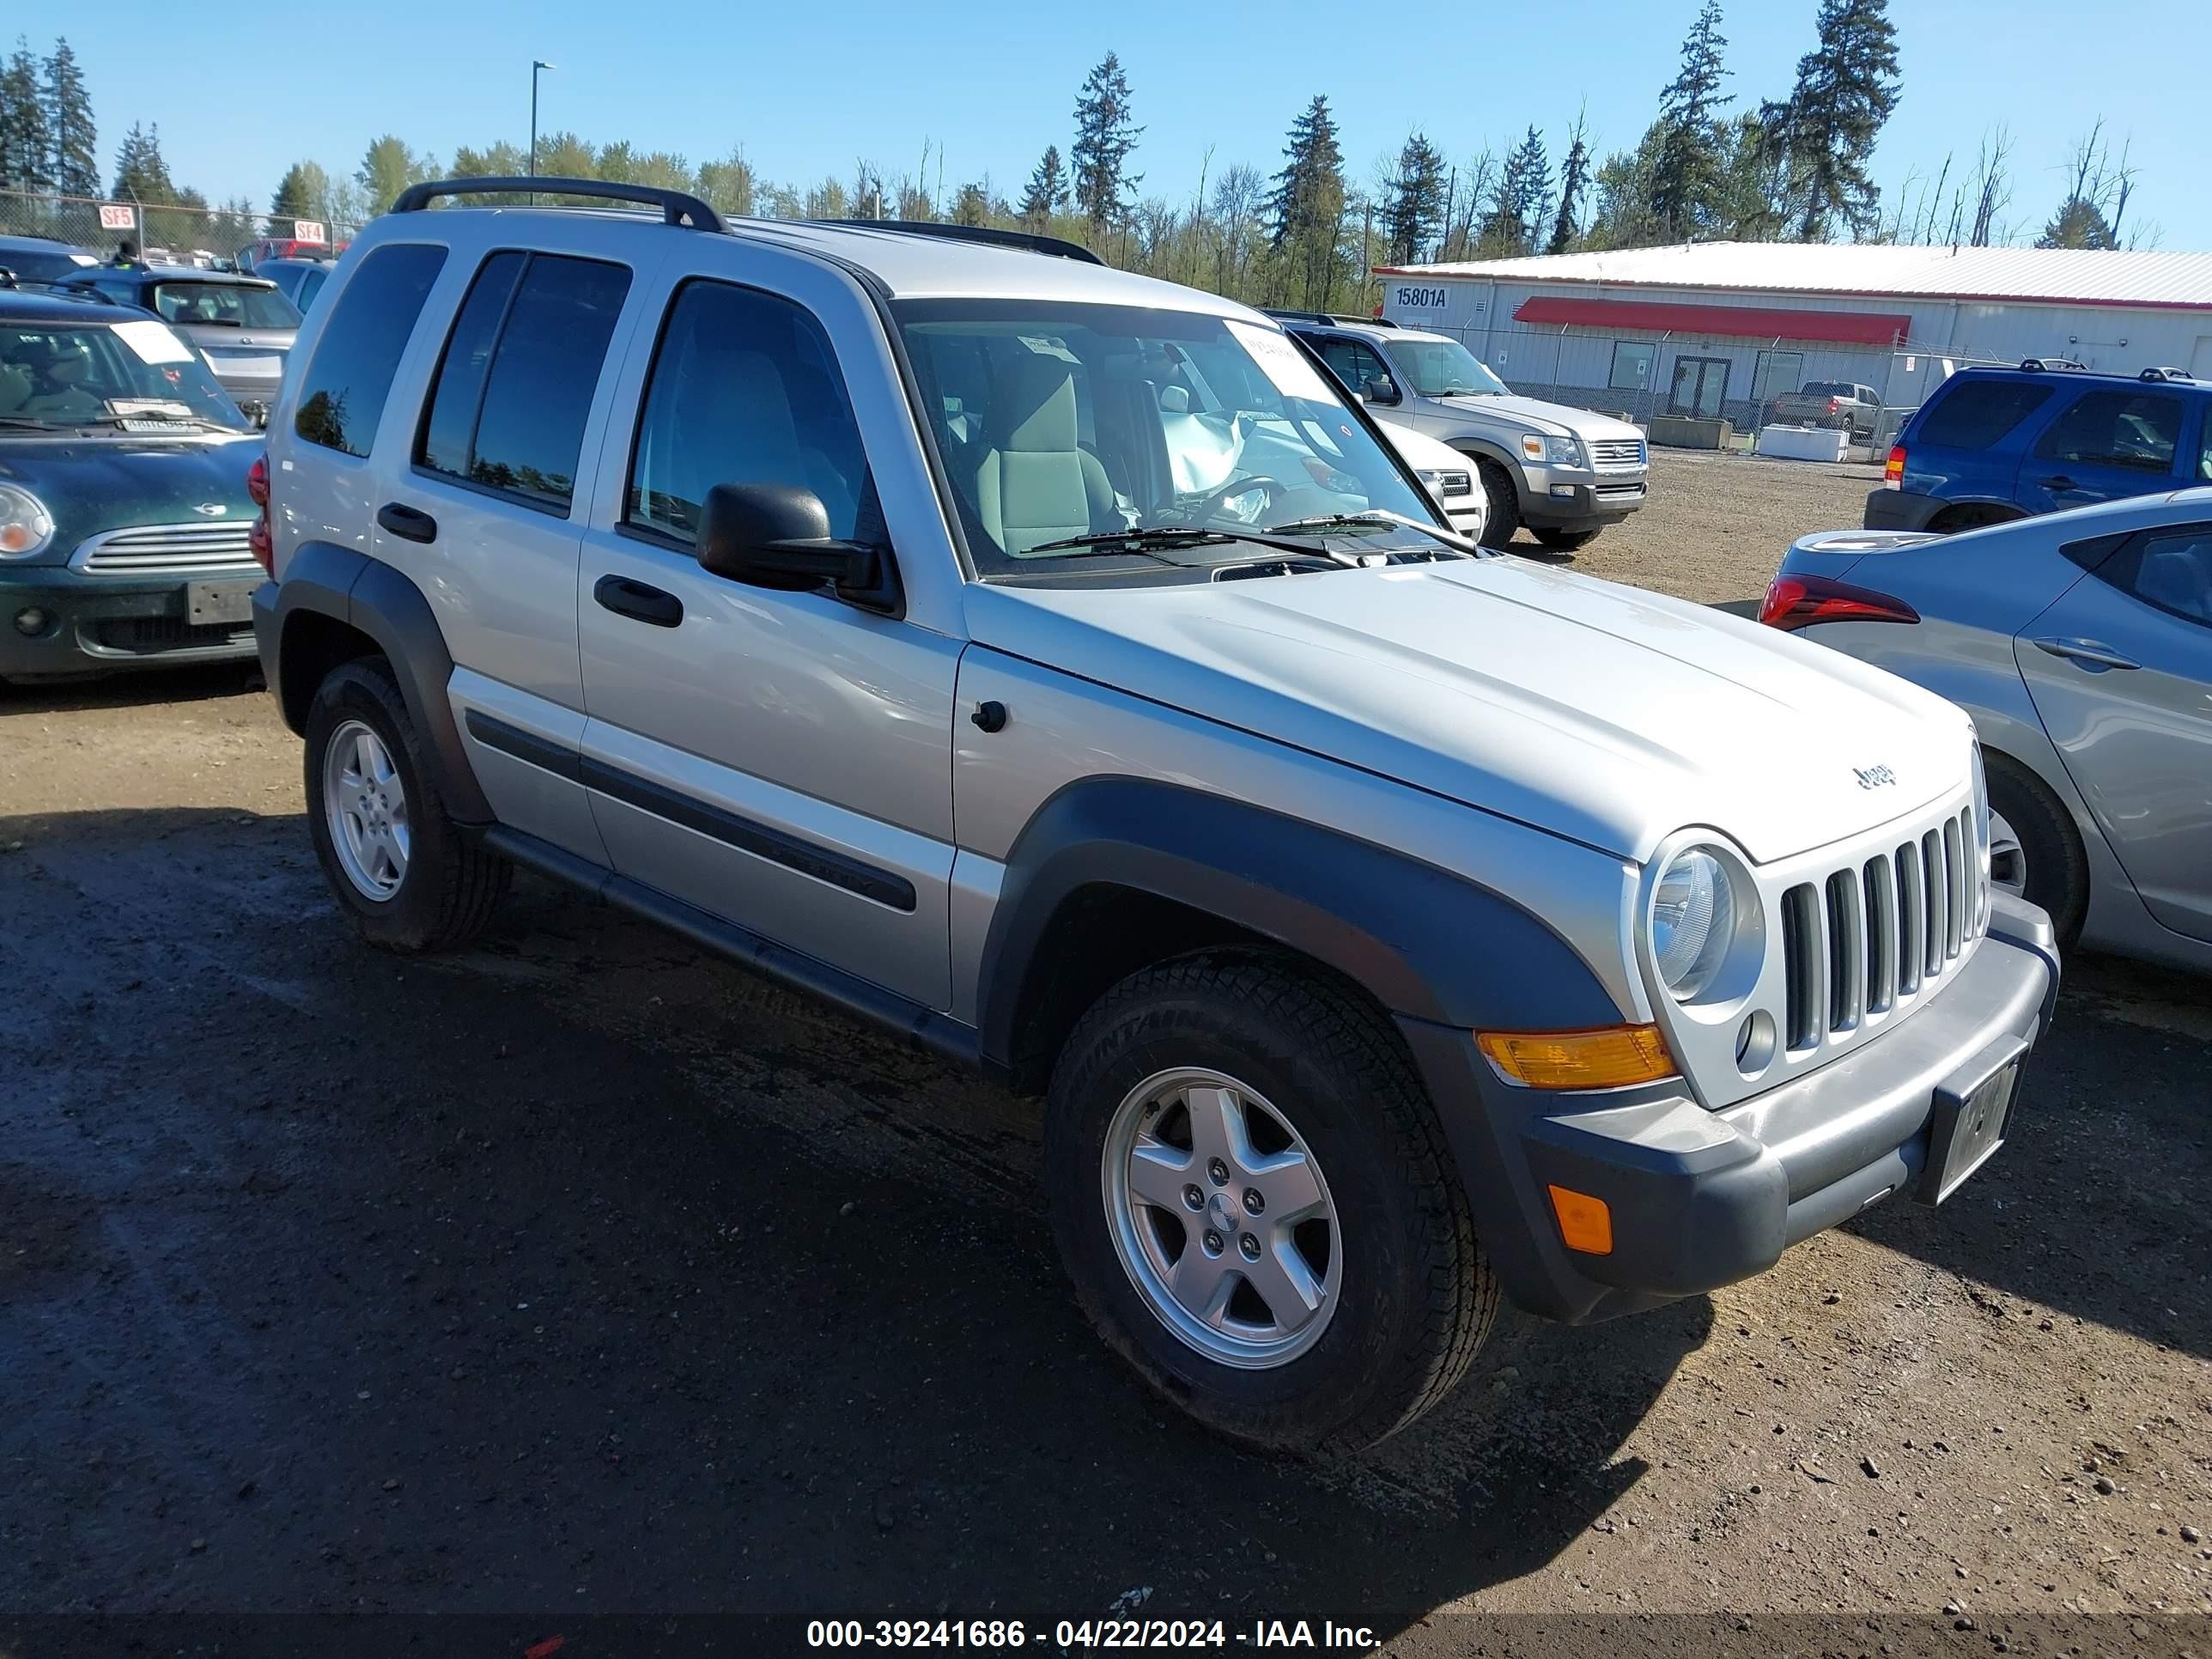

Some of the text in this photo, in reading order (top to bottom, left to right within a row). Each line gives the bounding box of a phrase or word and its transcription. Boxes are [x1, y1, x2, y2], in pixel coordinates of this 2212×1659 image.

[102, 208, 131, 226] SF5
[297, 222, 322, 240] SF4
[1396, 288, 1446, 307] 15801A
[1851, 764, 1897, 791] Jeep
